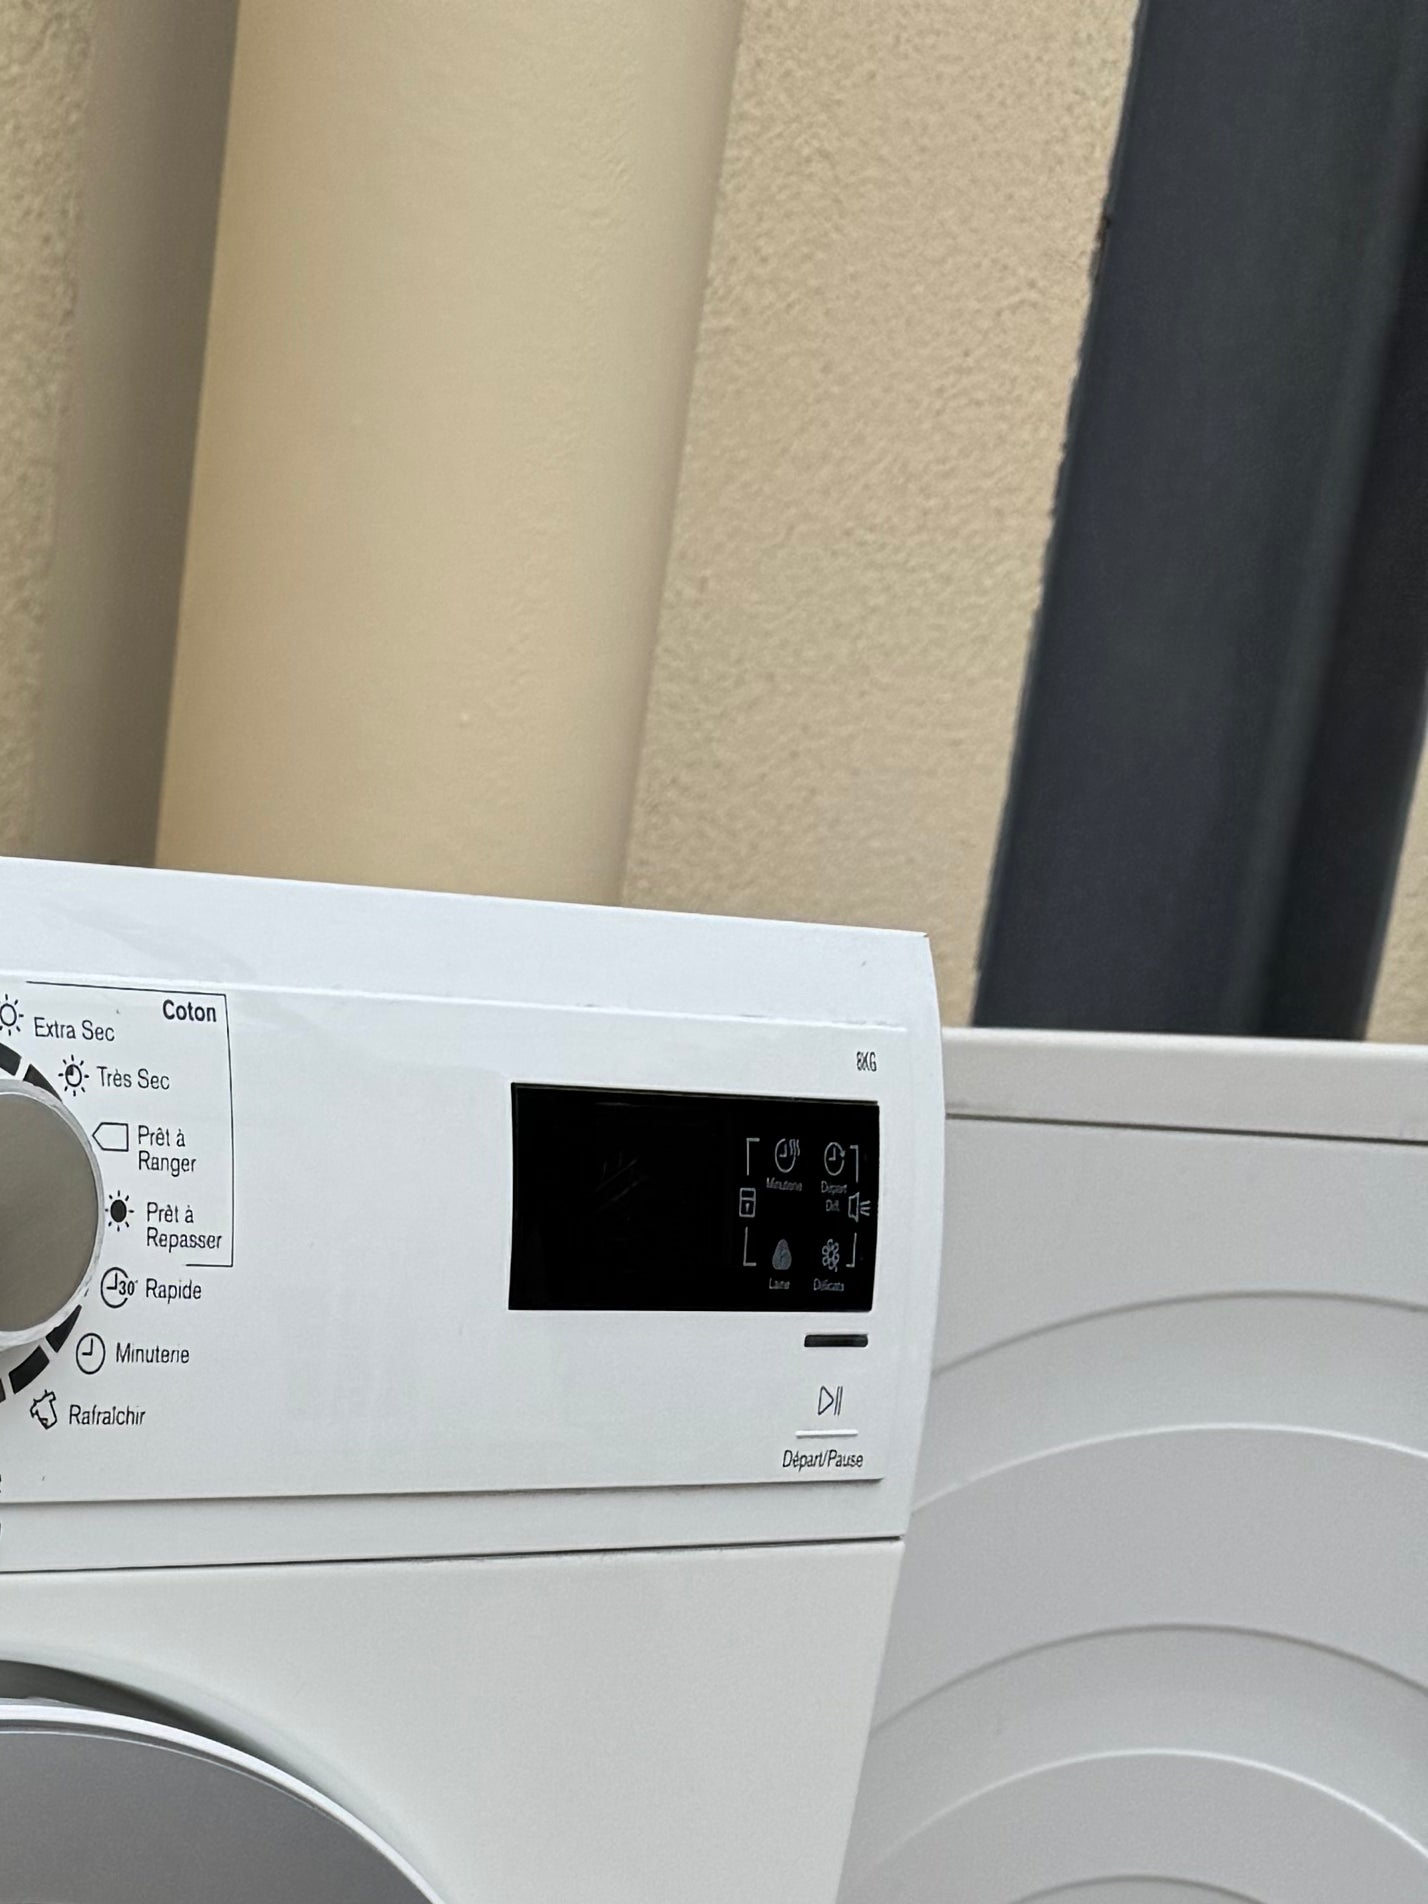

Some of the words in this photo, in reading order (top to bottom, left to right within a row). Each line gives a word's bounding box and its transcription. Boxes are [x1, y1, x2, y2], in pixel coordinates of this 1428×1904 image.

[162, 999, 218, 1023] Coton
[33, 1016, 77, 1040] Extra
[81, 1020, 116, 1042] Sec
[97, 1065, 133, 1088] Très
[137, 1068, 170, 1090] Sec
[137, 1125, 170, 1148] Prêt
[176, 1128, 186, 1148] à
[138, 1150, 197, 1177] Ranger
[146, 1201, 179, 1223] Prêt
[184, 1204, 195, 1224] à
[146, 1226, 223, 1253] Repasser
[145, 1277, 202, 1304] Rapide
[115, 1342, 190, 1364] Minuterie
[68, 1403, 146, 1426] Rafraîchir
[782, 1449, 864, 1472] Départ/Pause
